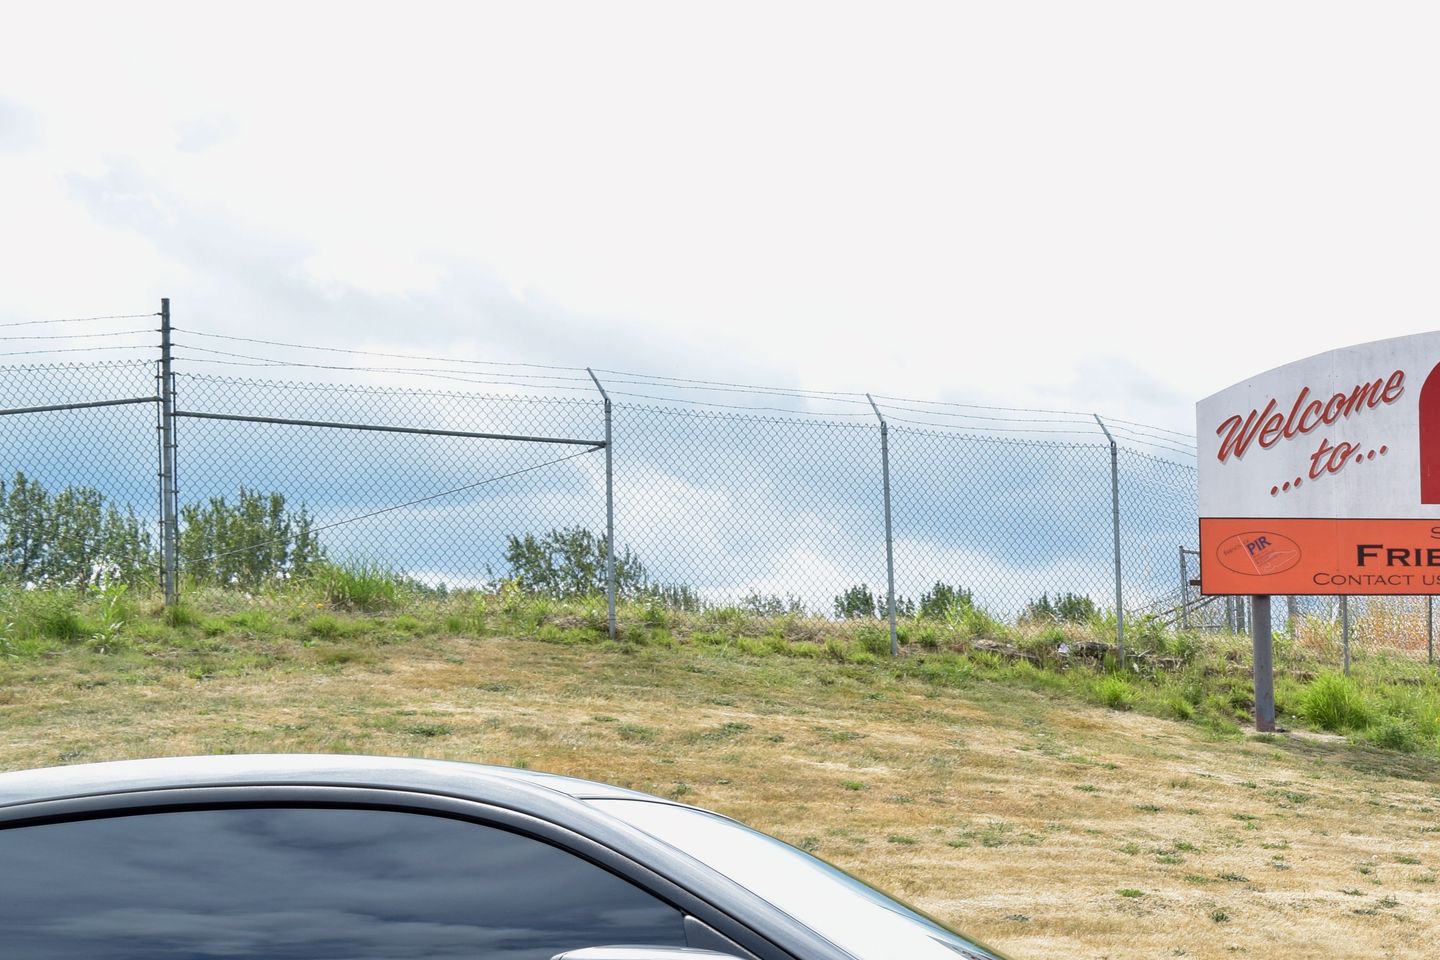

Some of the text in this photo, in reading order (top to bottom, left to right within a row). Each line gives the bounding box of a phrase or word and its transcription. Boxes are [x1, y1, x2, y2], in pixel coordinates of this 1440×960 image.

[1215, 369, 1405, 464] Welcome
[1247, 536, 1271, 555] PIR
[1312, 572, 1415, 586] CONTACT
